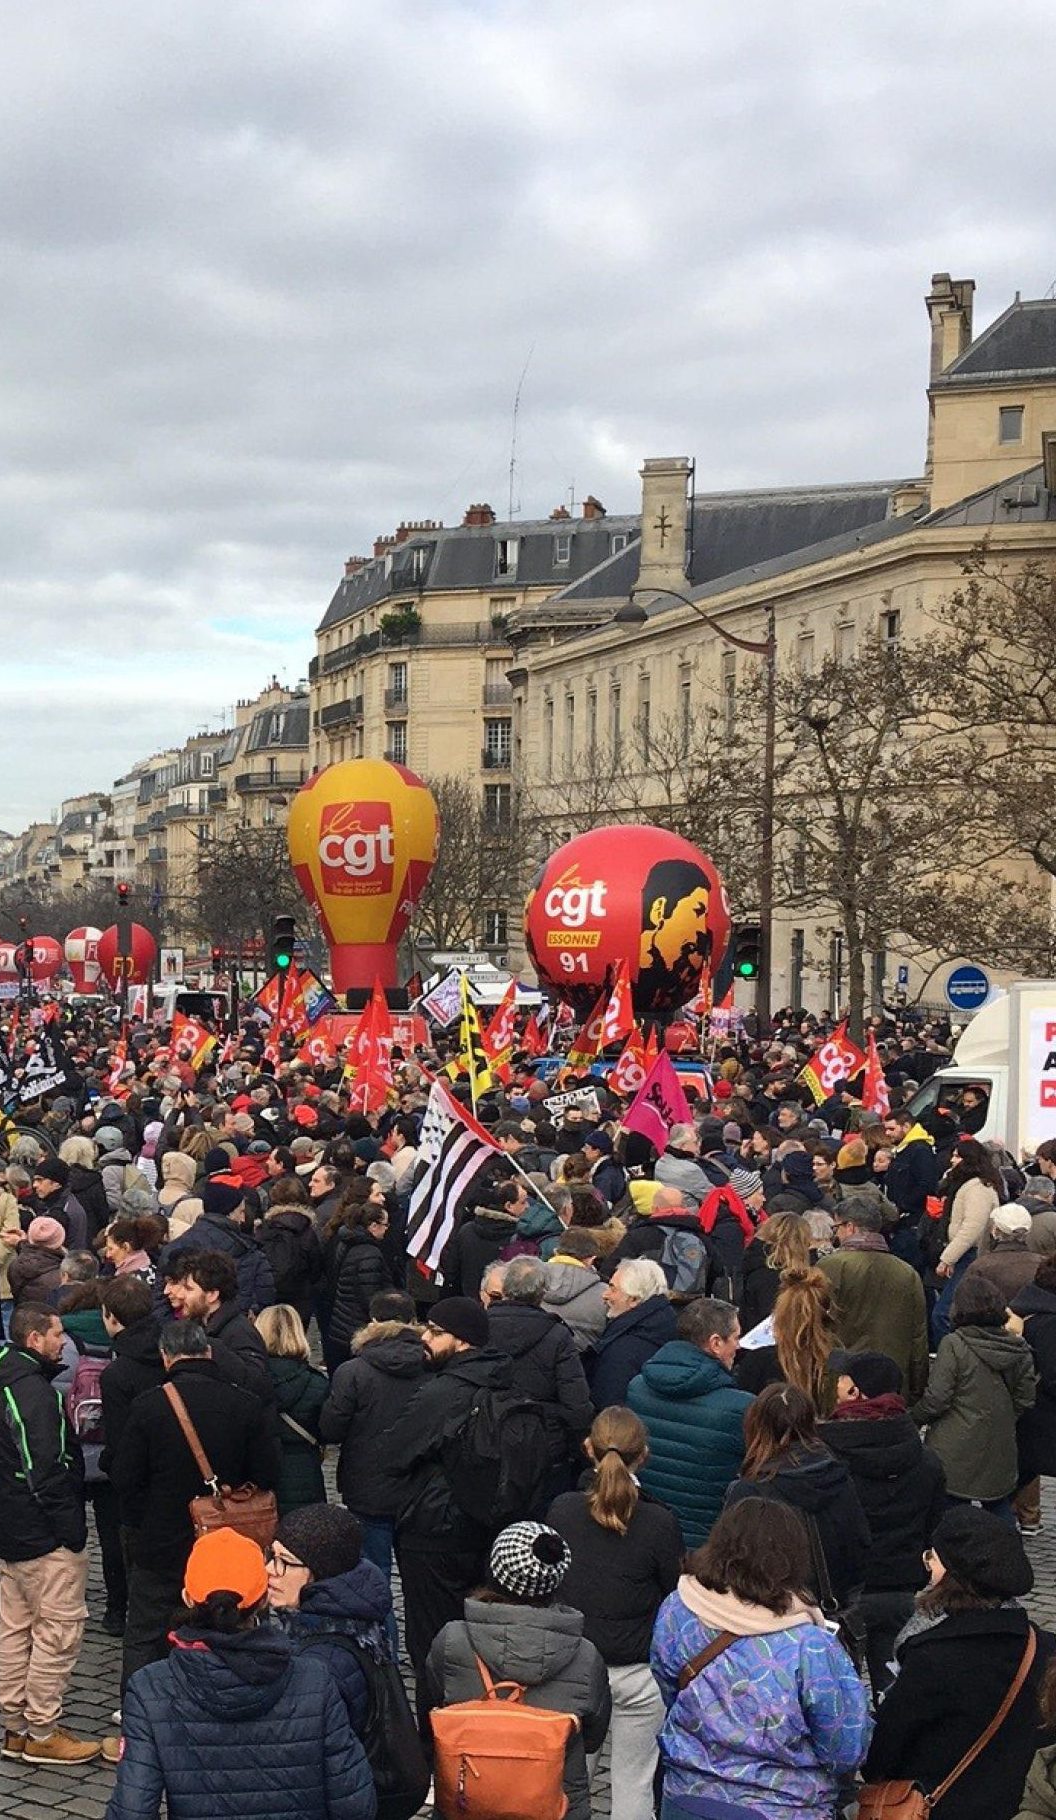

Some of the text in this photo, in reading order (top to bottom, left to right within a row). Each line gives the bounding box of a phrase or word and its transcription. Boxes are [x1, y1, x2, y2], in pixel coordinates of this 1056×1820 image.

[321, 803, 381, 836] la
[319, 824, 394, 876] cgt
[544, 879, 608, 927] cgt
[548, 932, 598, 945] ESSONNE
[559, 952, 589, 973] 91
